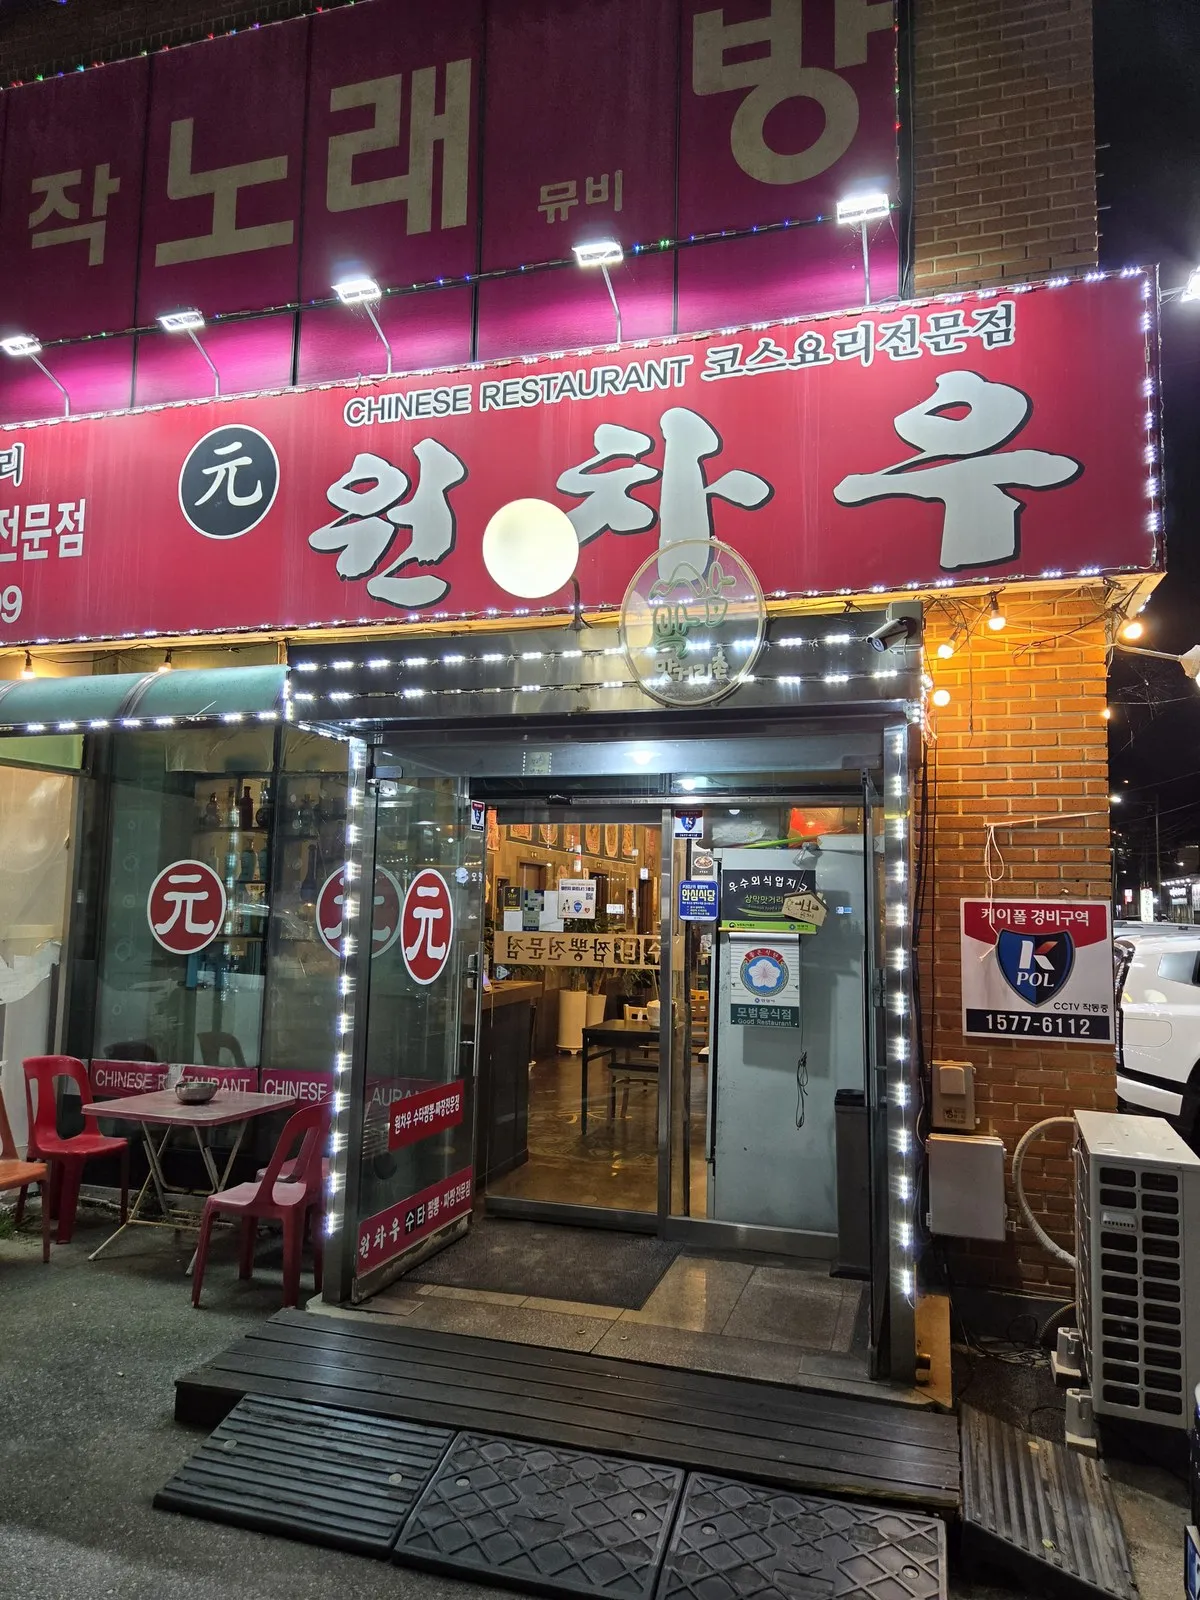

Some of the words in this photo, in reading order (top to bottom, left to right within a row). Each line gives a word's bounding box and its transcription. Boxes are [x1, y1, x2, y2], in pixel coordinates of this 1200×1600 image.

[538, 170, 623, 224] 뮤비
[702, 303, 1014, 379] 코스요리전문점
[347, 386, 470, 425] CHINESE
[482, 357, 691, 409] RESTAURANT
[194, 441, 262, 507] 元
[154, 874, 216, 935] 元
[682, 889, 716, 902] 안심식당
[405, 885, 446, 961] 元
[981, 908, 1028, 925] 케이폴
[1030, 909, 1090, 927] 경비구역
[1016, 972, 1055, 988] POL
[737, 1007, 792, 1020] 모범음식점
[1053, 1001, 1080, 1011] CCTV
[1083, 1003, 1109, 1014] 작동중
[757, 1019, 792, 1027] Restaurant
[986, 1014, 1091, 1035] 1577-6112
[95, 1069, 153, 1089] CHINESE
[264, 1079, 328, 1101] CHINESE
[405, 1203, 426, 1232] 수타
